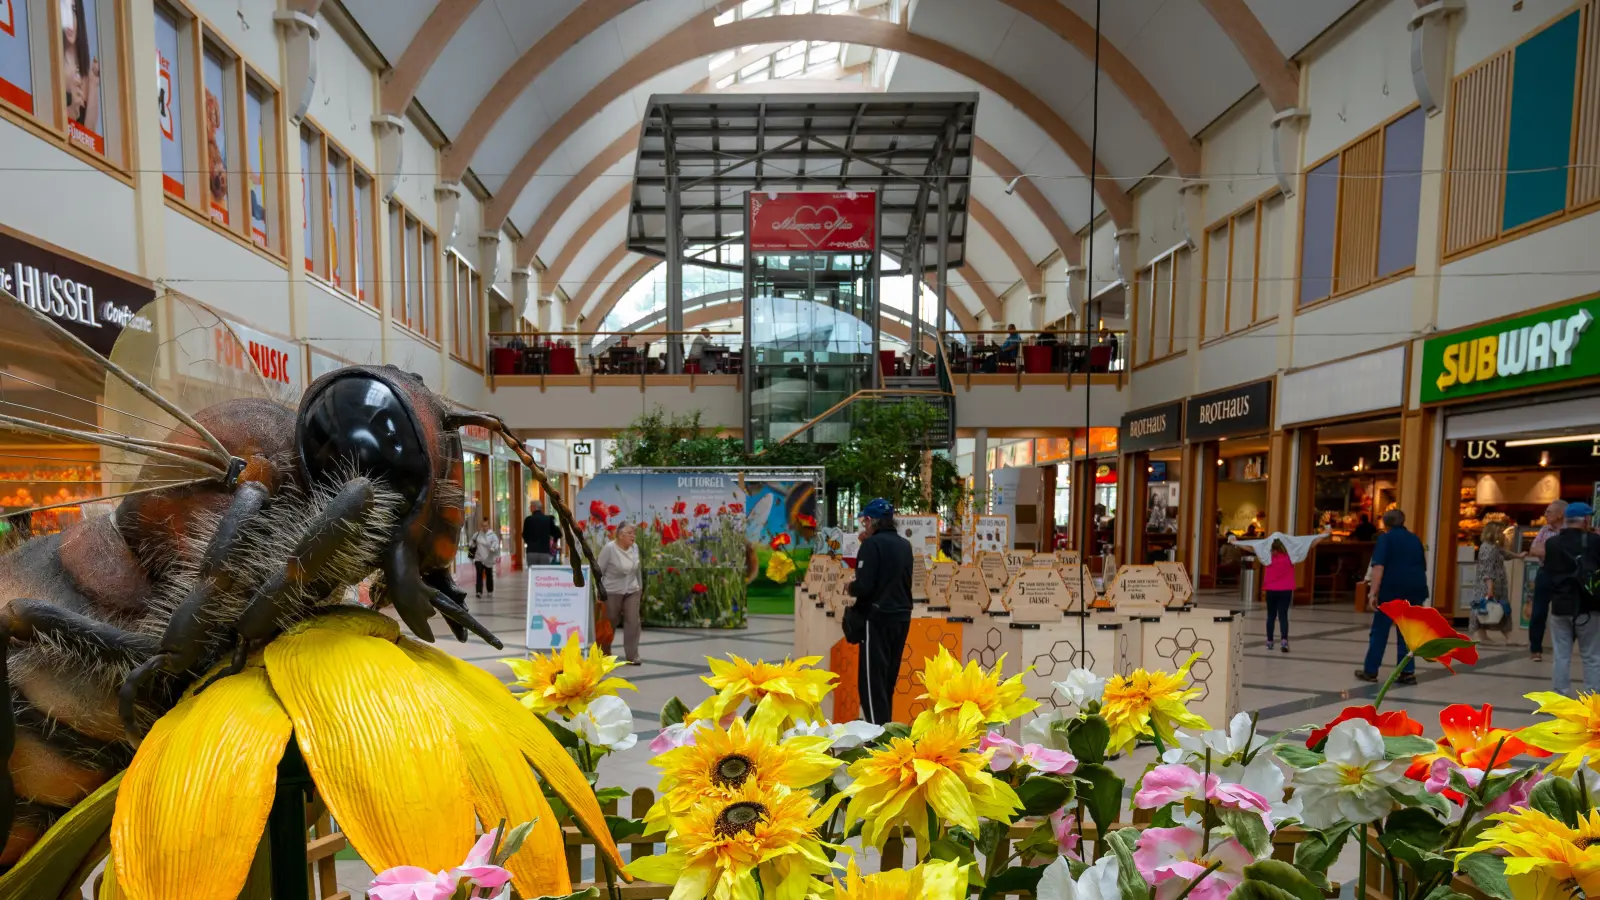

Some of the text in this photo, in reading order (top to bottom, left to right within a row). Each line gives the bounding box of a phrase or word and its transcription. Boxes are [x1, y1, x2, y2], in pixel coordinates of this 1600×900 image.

[771, 215, 853, 230] Mamma Mia
[14, 262, 102, 328] HUSSEL
[214, 327, 290, 384] FOR MUSIC
[1436, 308, 1593, 392] SUBWAY
[677, 476, 725, 488] DUFTORGEL
[1019, 582, 1025, 595] 5
[1120, 579, 1126, 592] 4
[1029, 596, 1050, 604] FALSCH
